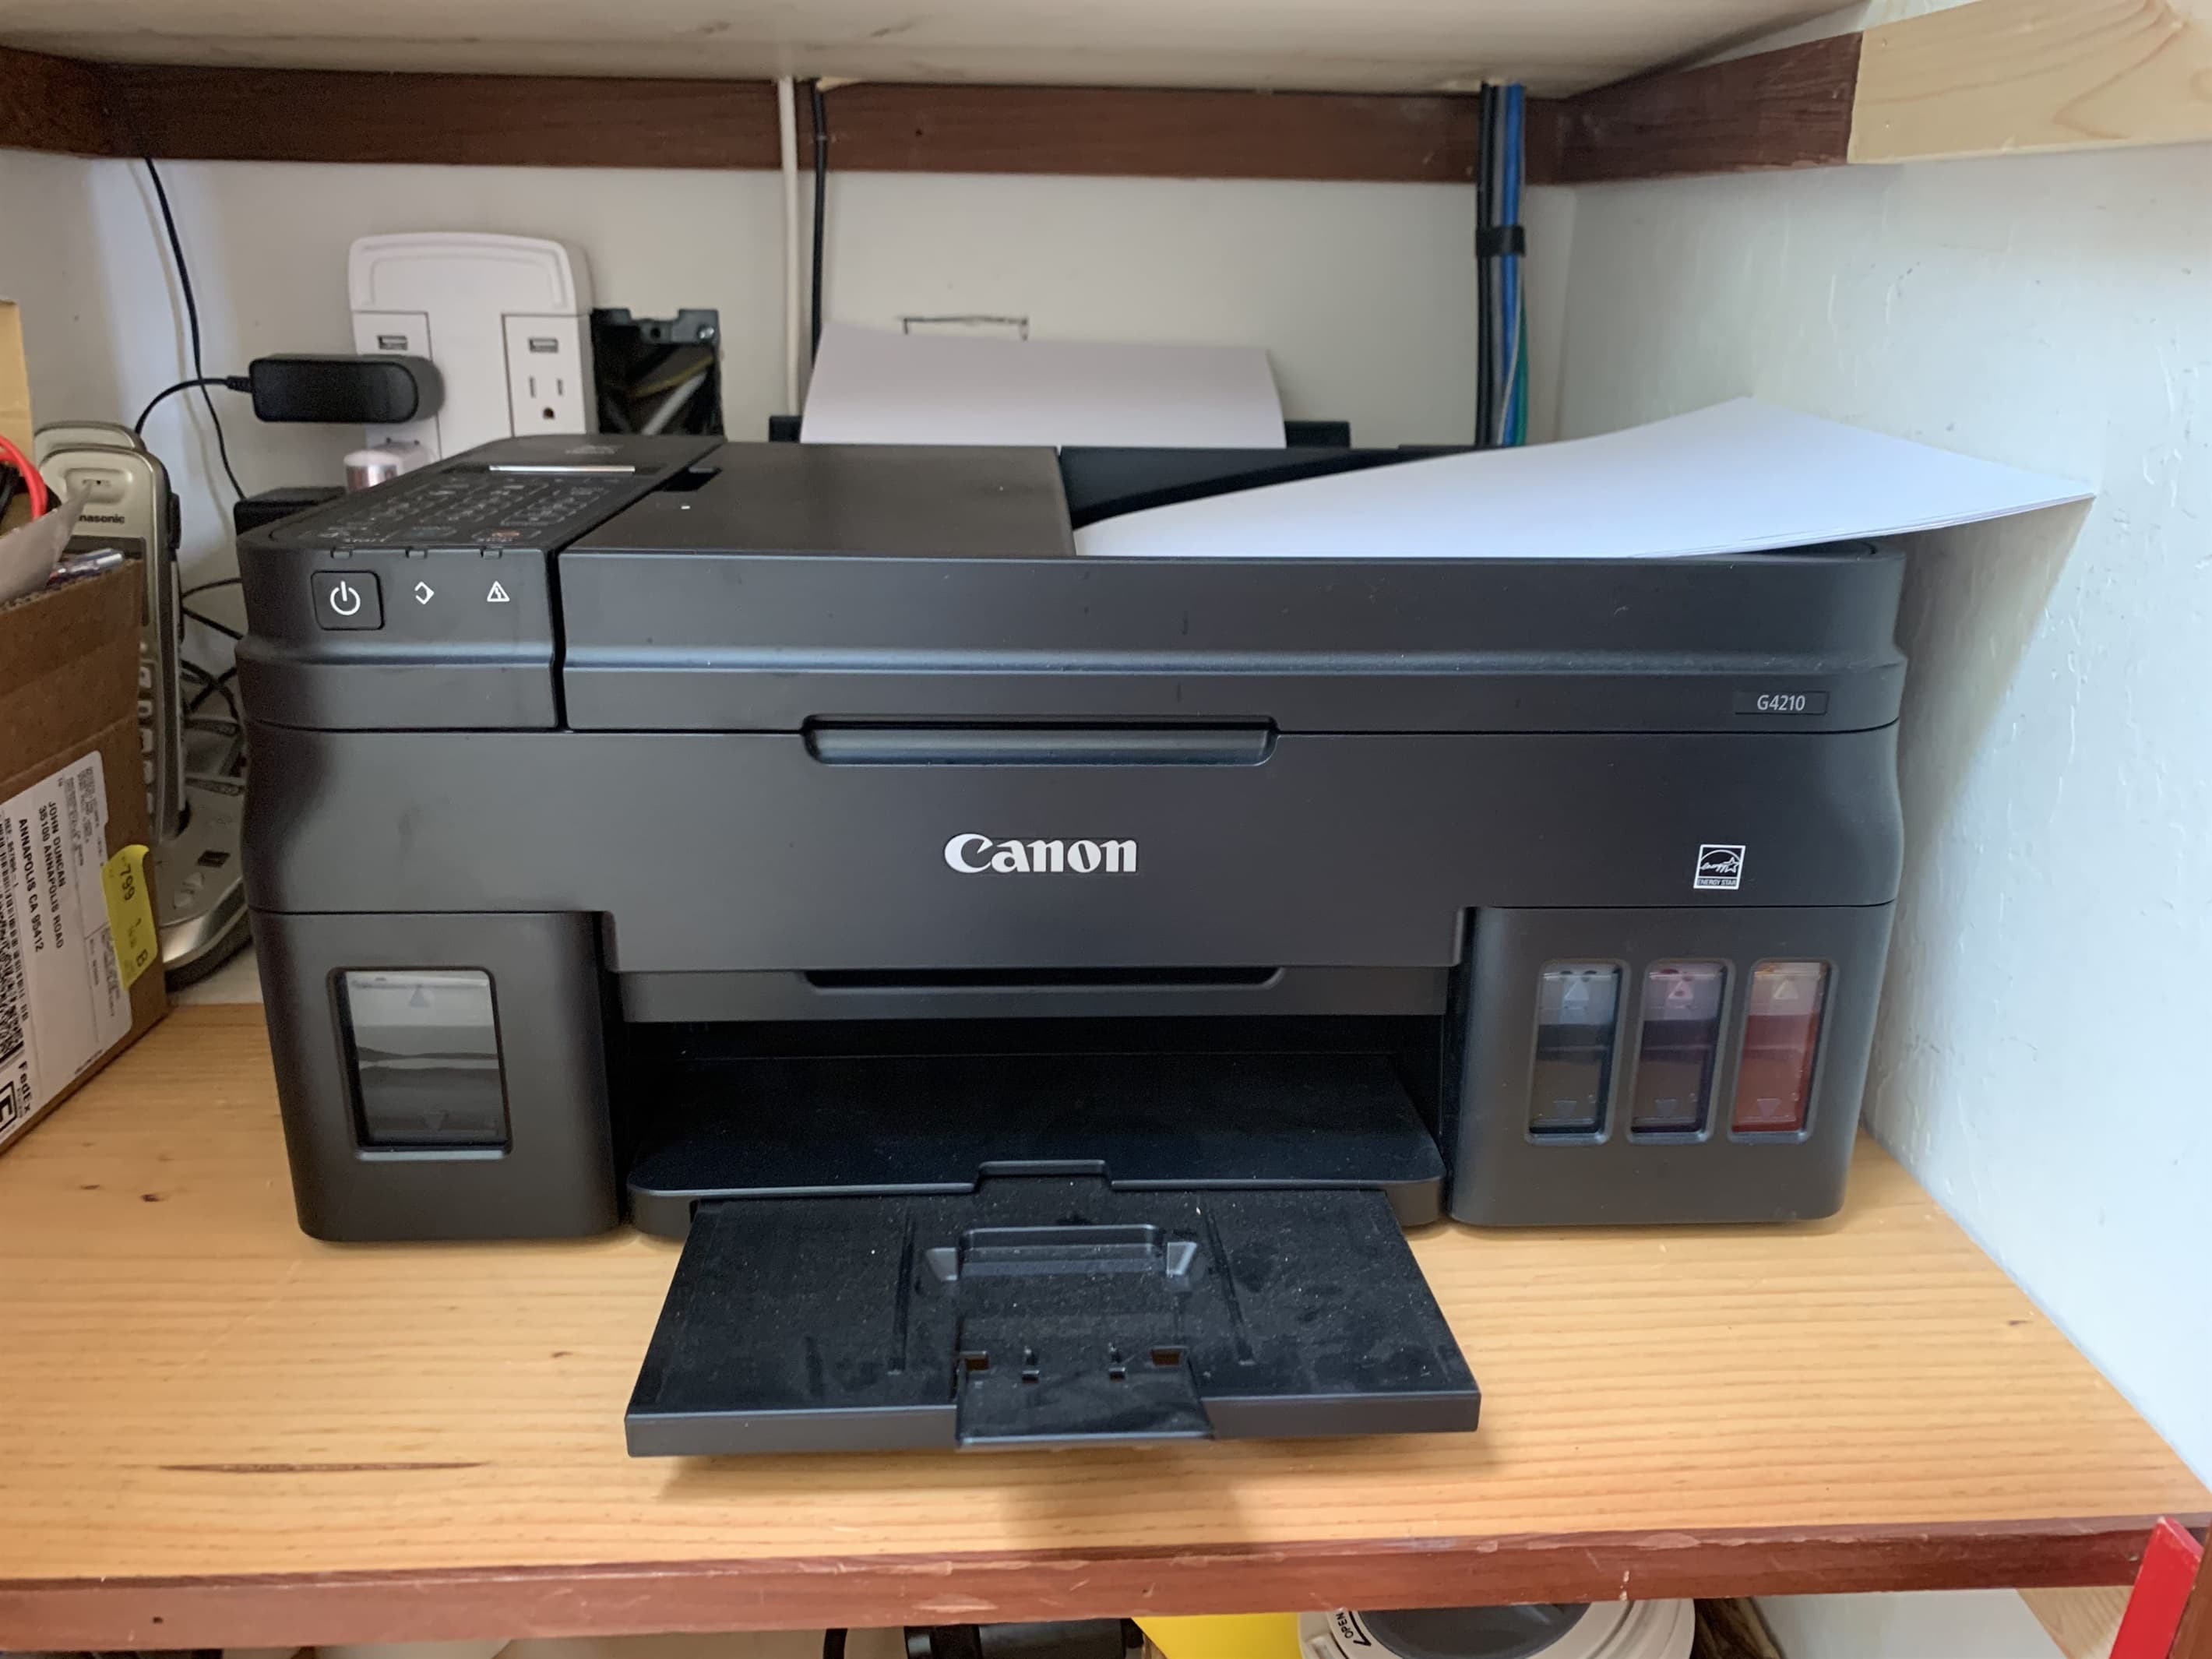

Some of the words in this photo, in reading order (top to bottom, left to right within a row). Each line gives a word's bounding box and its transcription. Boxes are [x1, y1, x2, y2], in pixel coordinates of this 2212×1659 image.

[78, 514, 125, 524] nasonic
[1756, 695, 1805, 711] G4210
[48, 801, 59, 835] JOHN
[19, 819, 37, 892] ANNAPOLIS
[52, 836, 66, 888] DUNCAN
[944, 833, 1137, 874] Canon
[44, 845, 60, 913] ANNAPOLIS
[53, 912, 65, 949] ROAD
[120, 864, 136, 901] 799
[28, 893, 39, 914] CA
[31, 914, 44, 953] 95412
[19, 1061, 33, 1114] FedEx
[1335, 1612, 1354, 1639] OPEN
